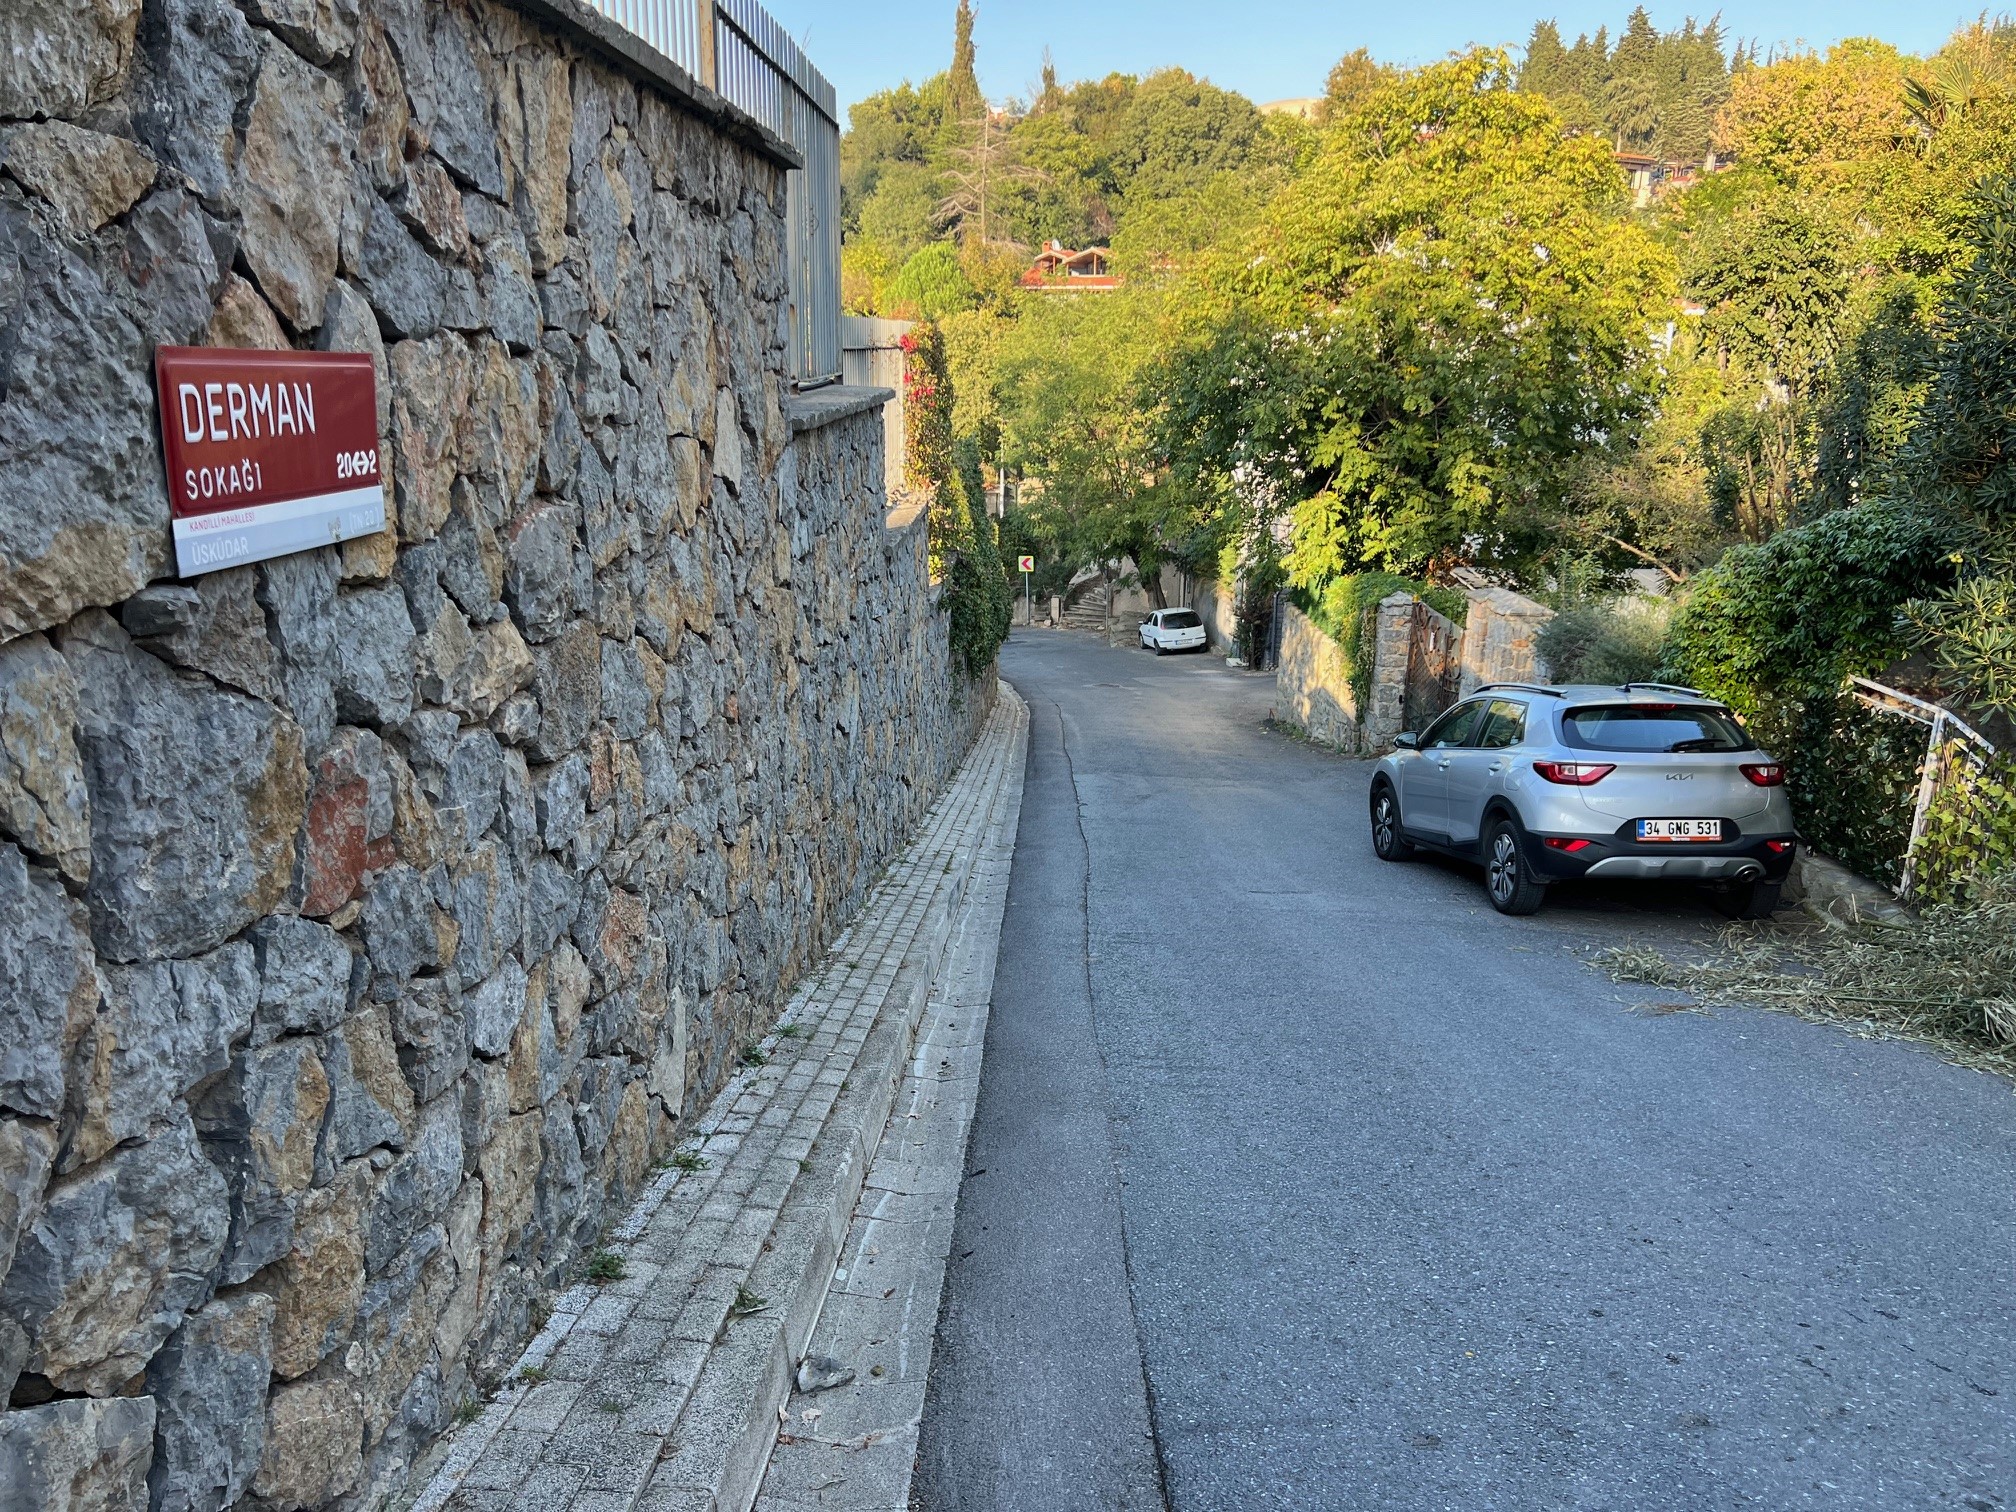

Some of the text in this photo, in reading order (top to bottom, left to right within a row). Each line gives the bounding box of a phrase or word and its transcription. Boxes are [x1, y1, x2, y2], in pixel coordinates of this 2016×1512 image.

[178, 382, 316, 443] DERMAN
[185, 457, 263, 501] SOKAĞI
[191, 536, 250, 566] ÜSKÜDAR
[1666, 772, 1695, 781] KIA
[1646, 821, 1718, 835] 34 GNG 531
